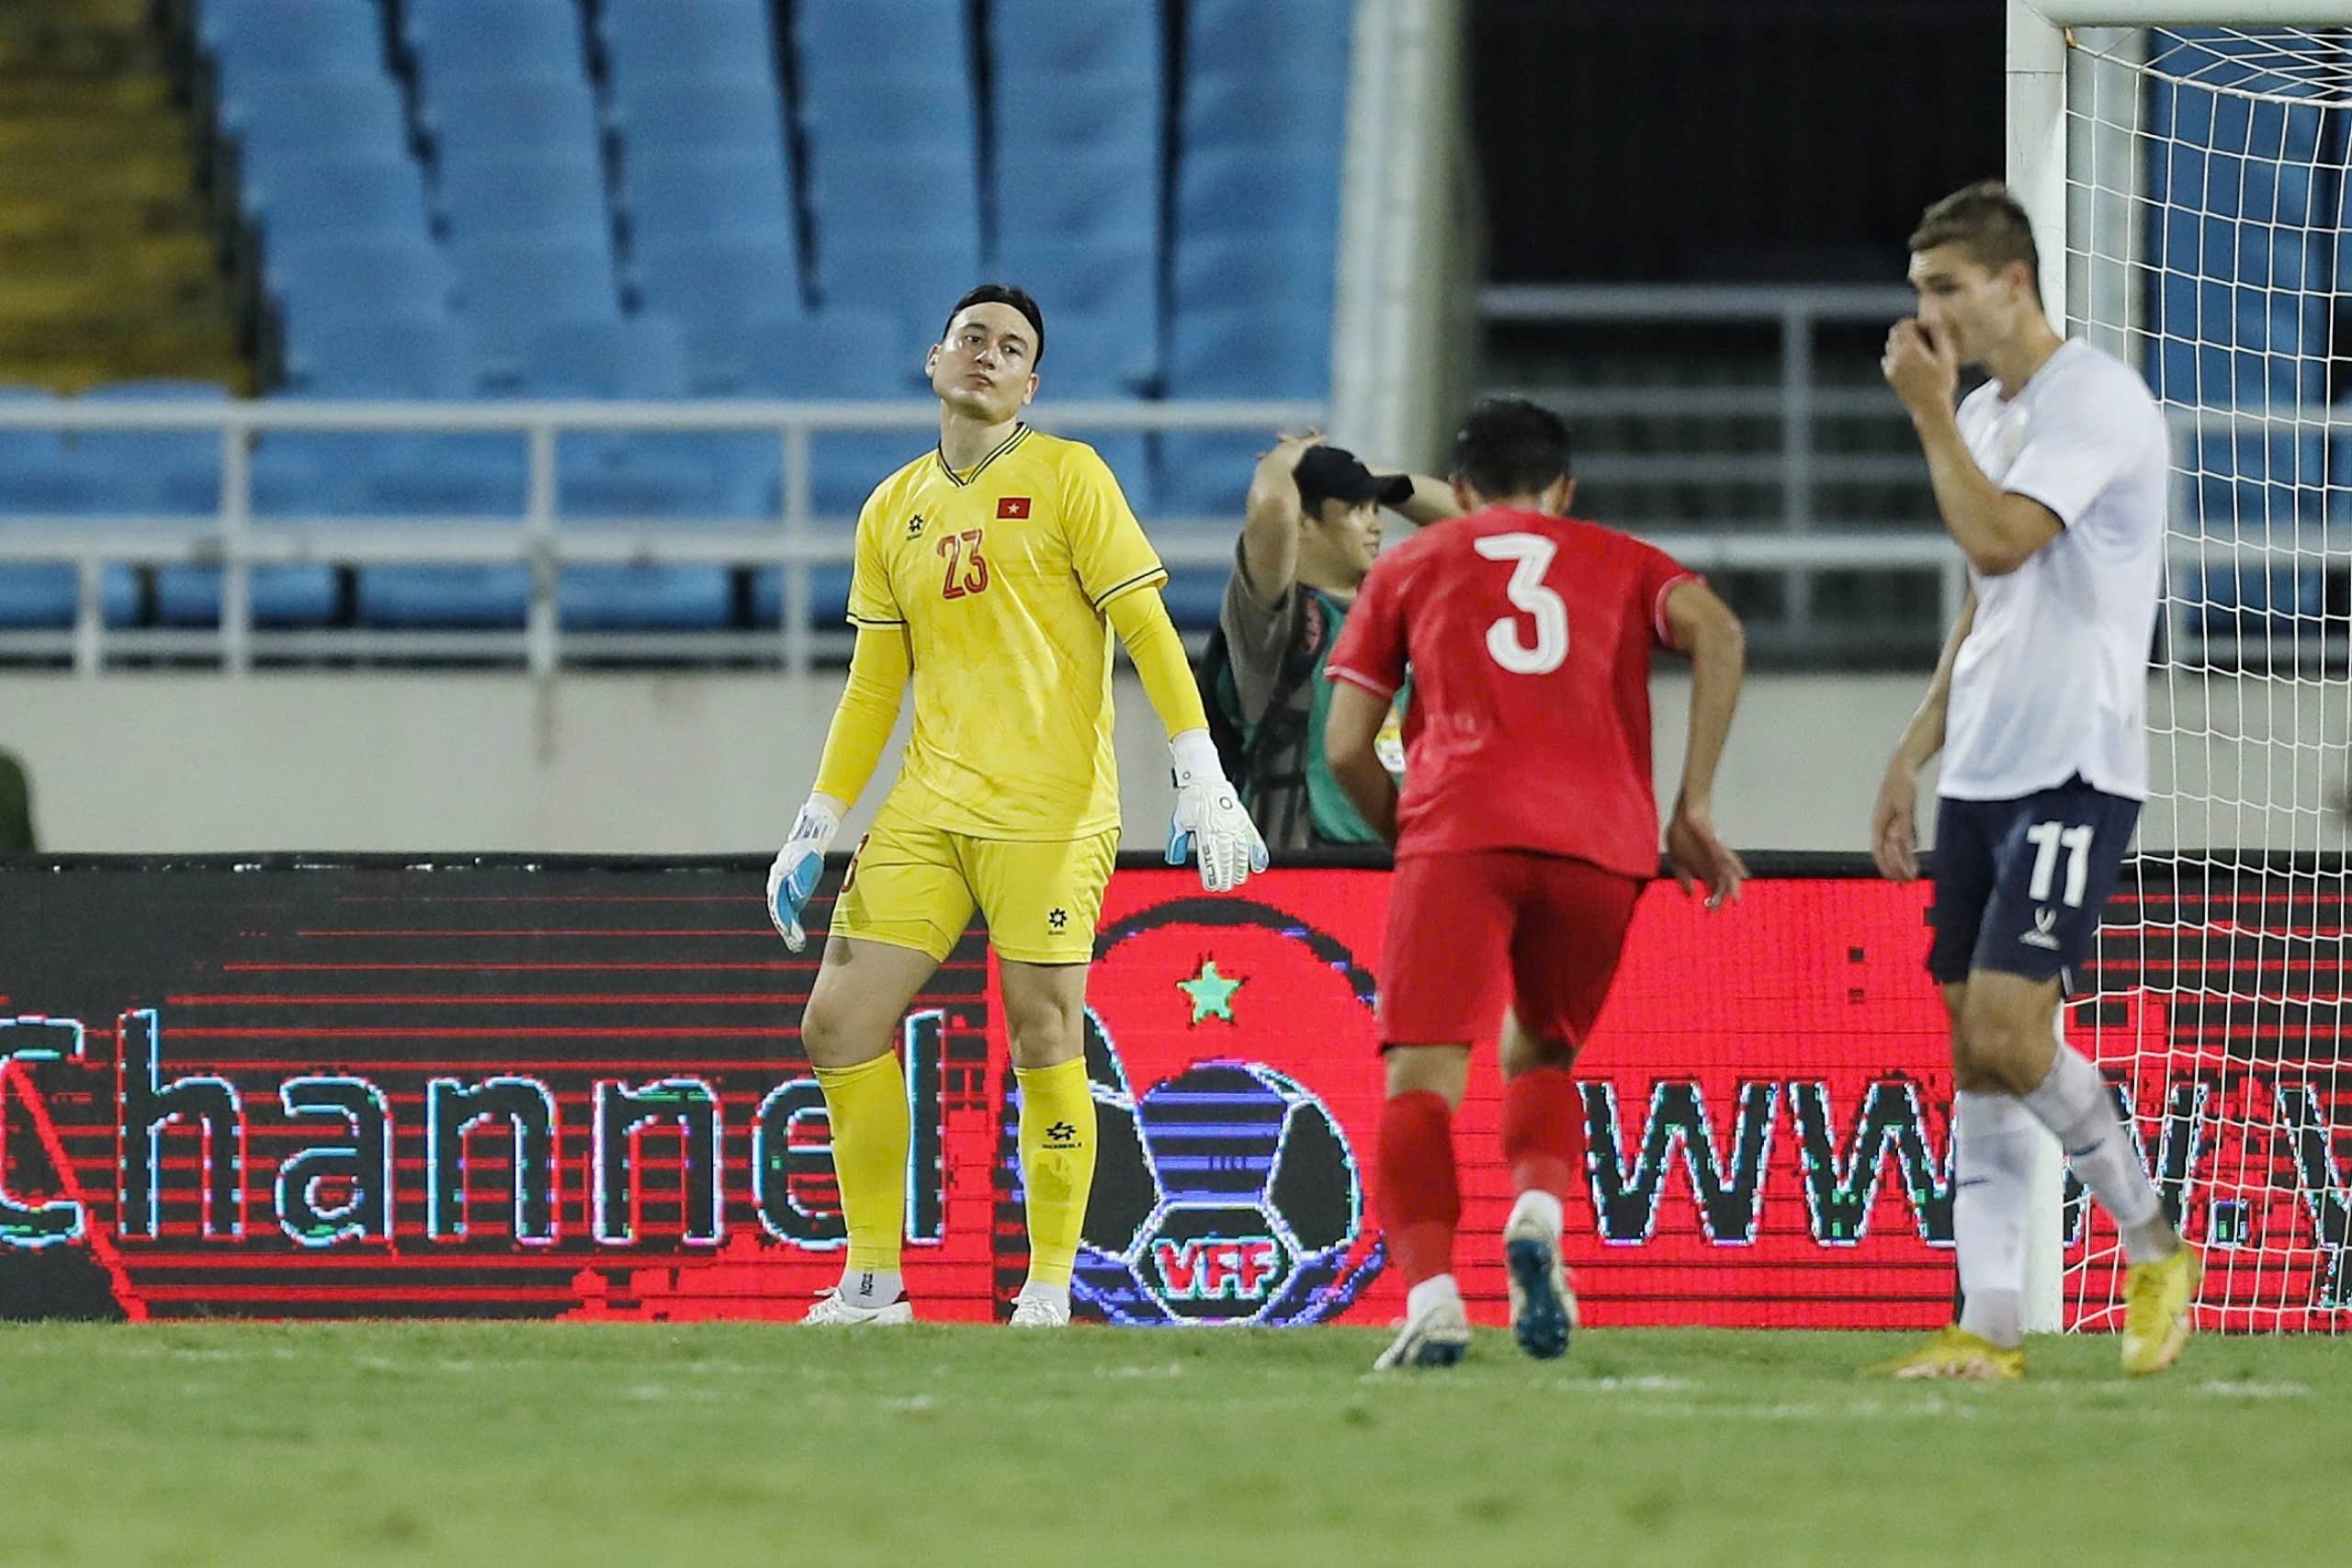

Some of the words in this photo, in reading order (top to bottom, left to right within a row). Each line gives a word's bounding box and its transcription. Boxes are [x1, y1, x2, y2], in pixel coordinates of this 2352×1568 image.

[936, 528, 989, 600] 23
[1474, 532, 1569, 675] 3
[2027, 820, 2095, 908] 11
[0, 1009, 945, 1250] Channel
[1150, 1236, 1280, 1300] VFF
